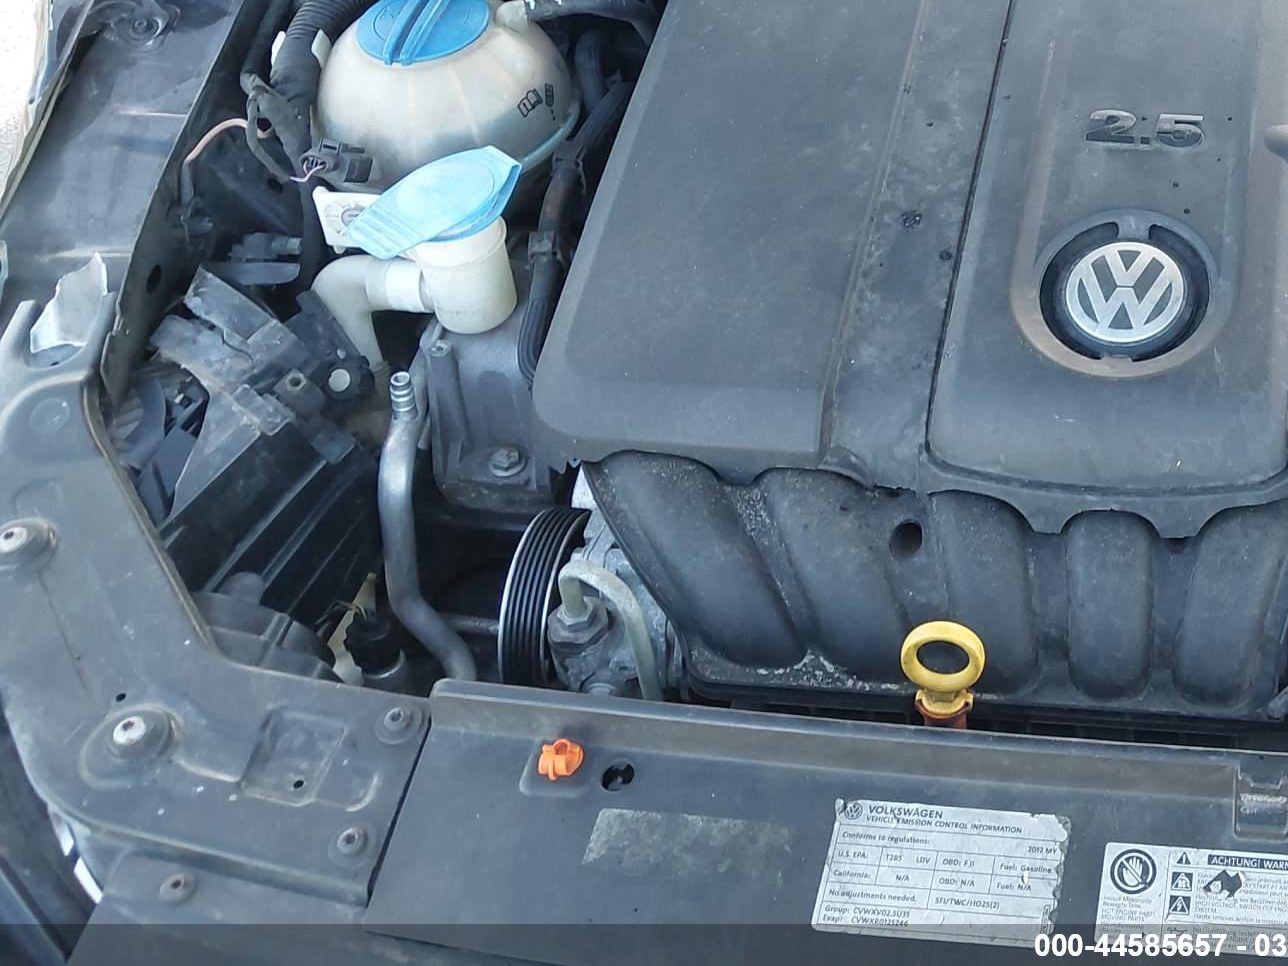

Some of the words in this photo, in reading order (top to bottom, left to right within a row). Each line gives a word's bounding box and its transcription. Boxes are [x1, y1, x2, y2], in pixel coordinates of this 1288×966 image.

[1085, 109, 1205, 150] 2.5
[1066, 242, 1184, 344] VW
[868, 805, 944, 818] VOLKSWAGEN
[934, 820, 968, 829] CONTROL
[970, 822, 1022, 834] INFORMATION
[842, 830, 876, 840] Conforms
[1211, 856, 1260, 868] ACHTUNG!
[1020, 864, 1052, 873] Gasoline
[833, 869, 871, 879] California:
[960, 878, 975, 886] N/A
[840, 890, 886, 900] adjustments
[824, 904, 850, 914] Group:
